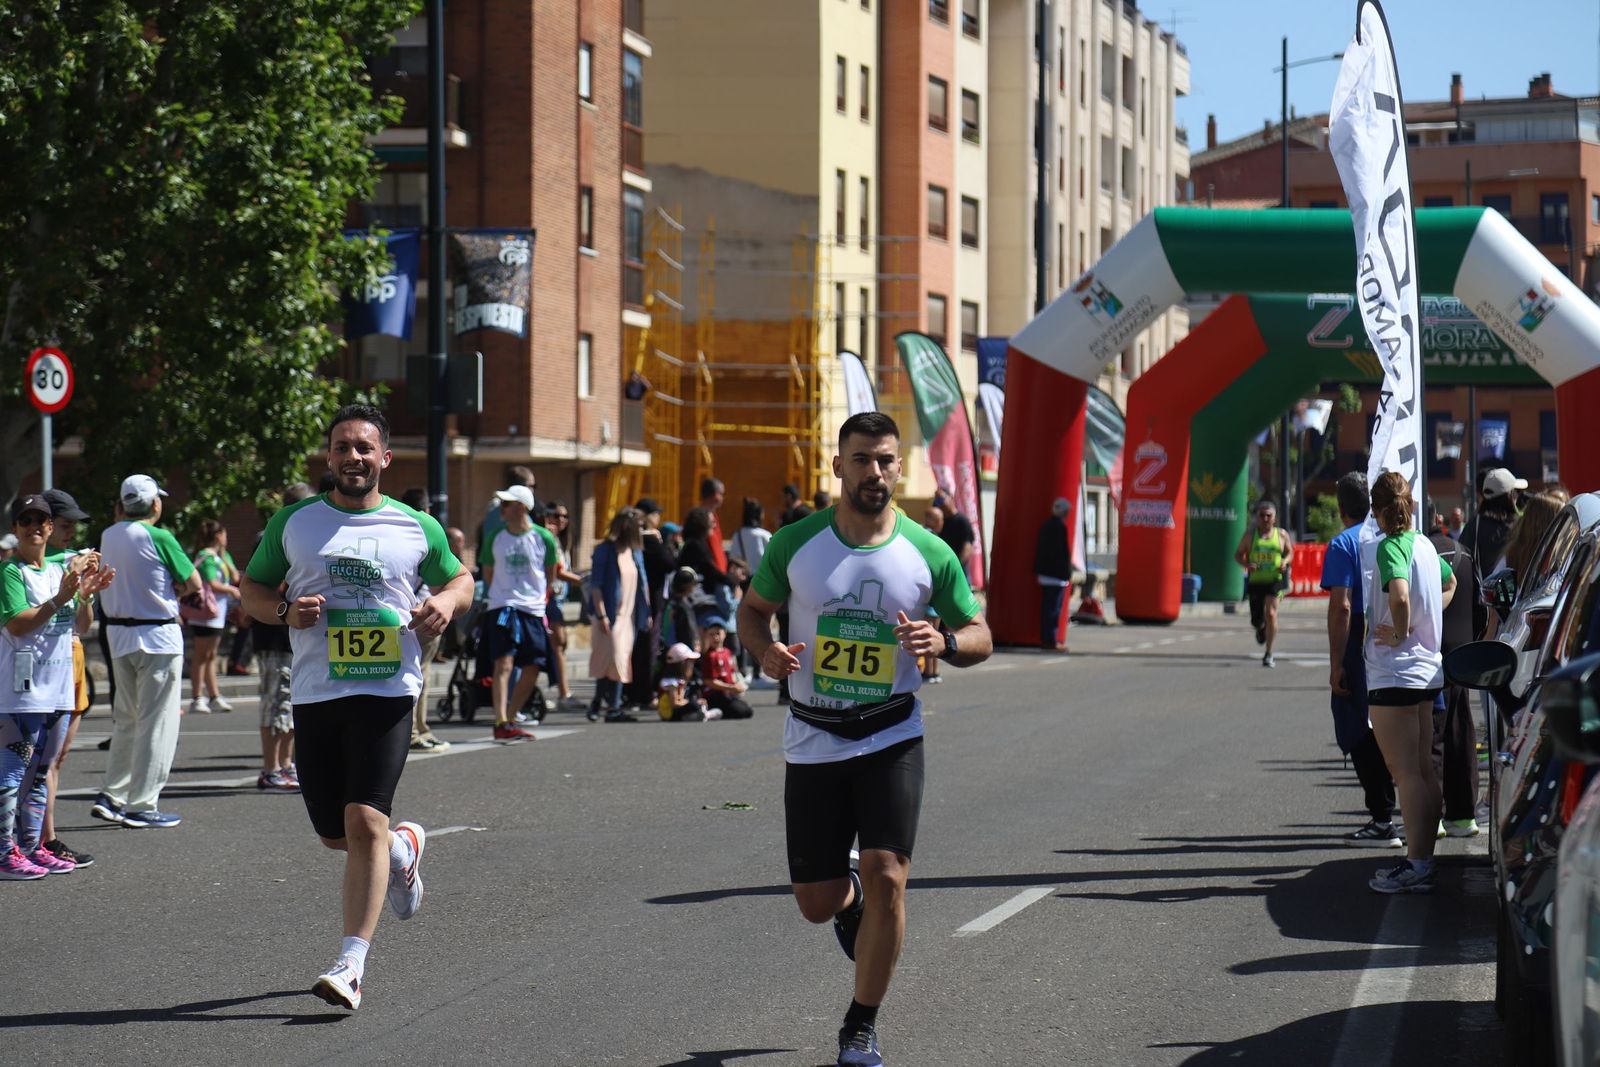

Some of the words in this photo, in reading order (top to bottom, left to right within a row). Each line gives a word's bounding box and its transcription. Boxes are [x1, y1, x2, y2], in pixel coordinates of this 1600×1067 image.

[36, 369, 64, 390] 30
[331, 566, 343, 576] EL
[345, 566, 381, 579] CERCO
[845, 609, 872, 619] CARRERA
[856, 630, 877, 639] RURAL
[332, 630, 386, 657] 152
[821, 640, 880, 676] 215
[348, 666, 368, 675] CAJA
[369, 665, 397, 674] RURAL
[833, 683, 856, 694] CAJA
[857, 687, 888, 697] RURAL
